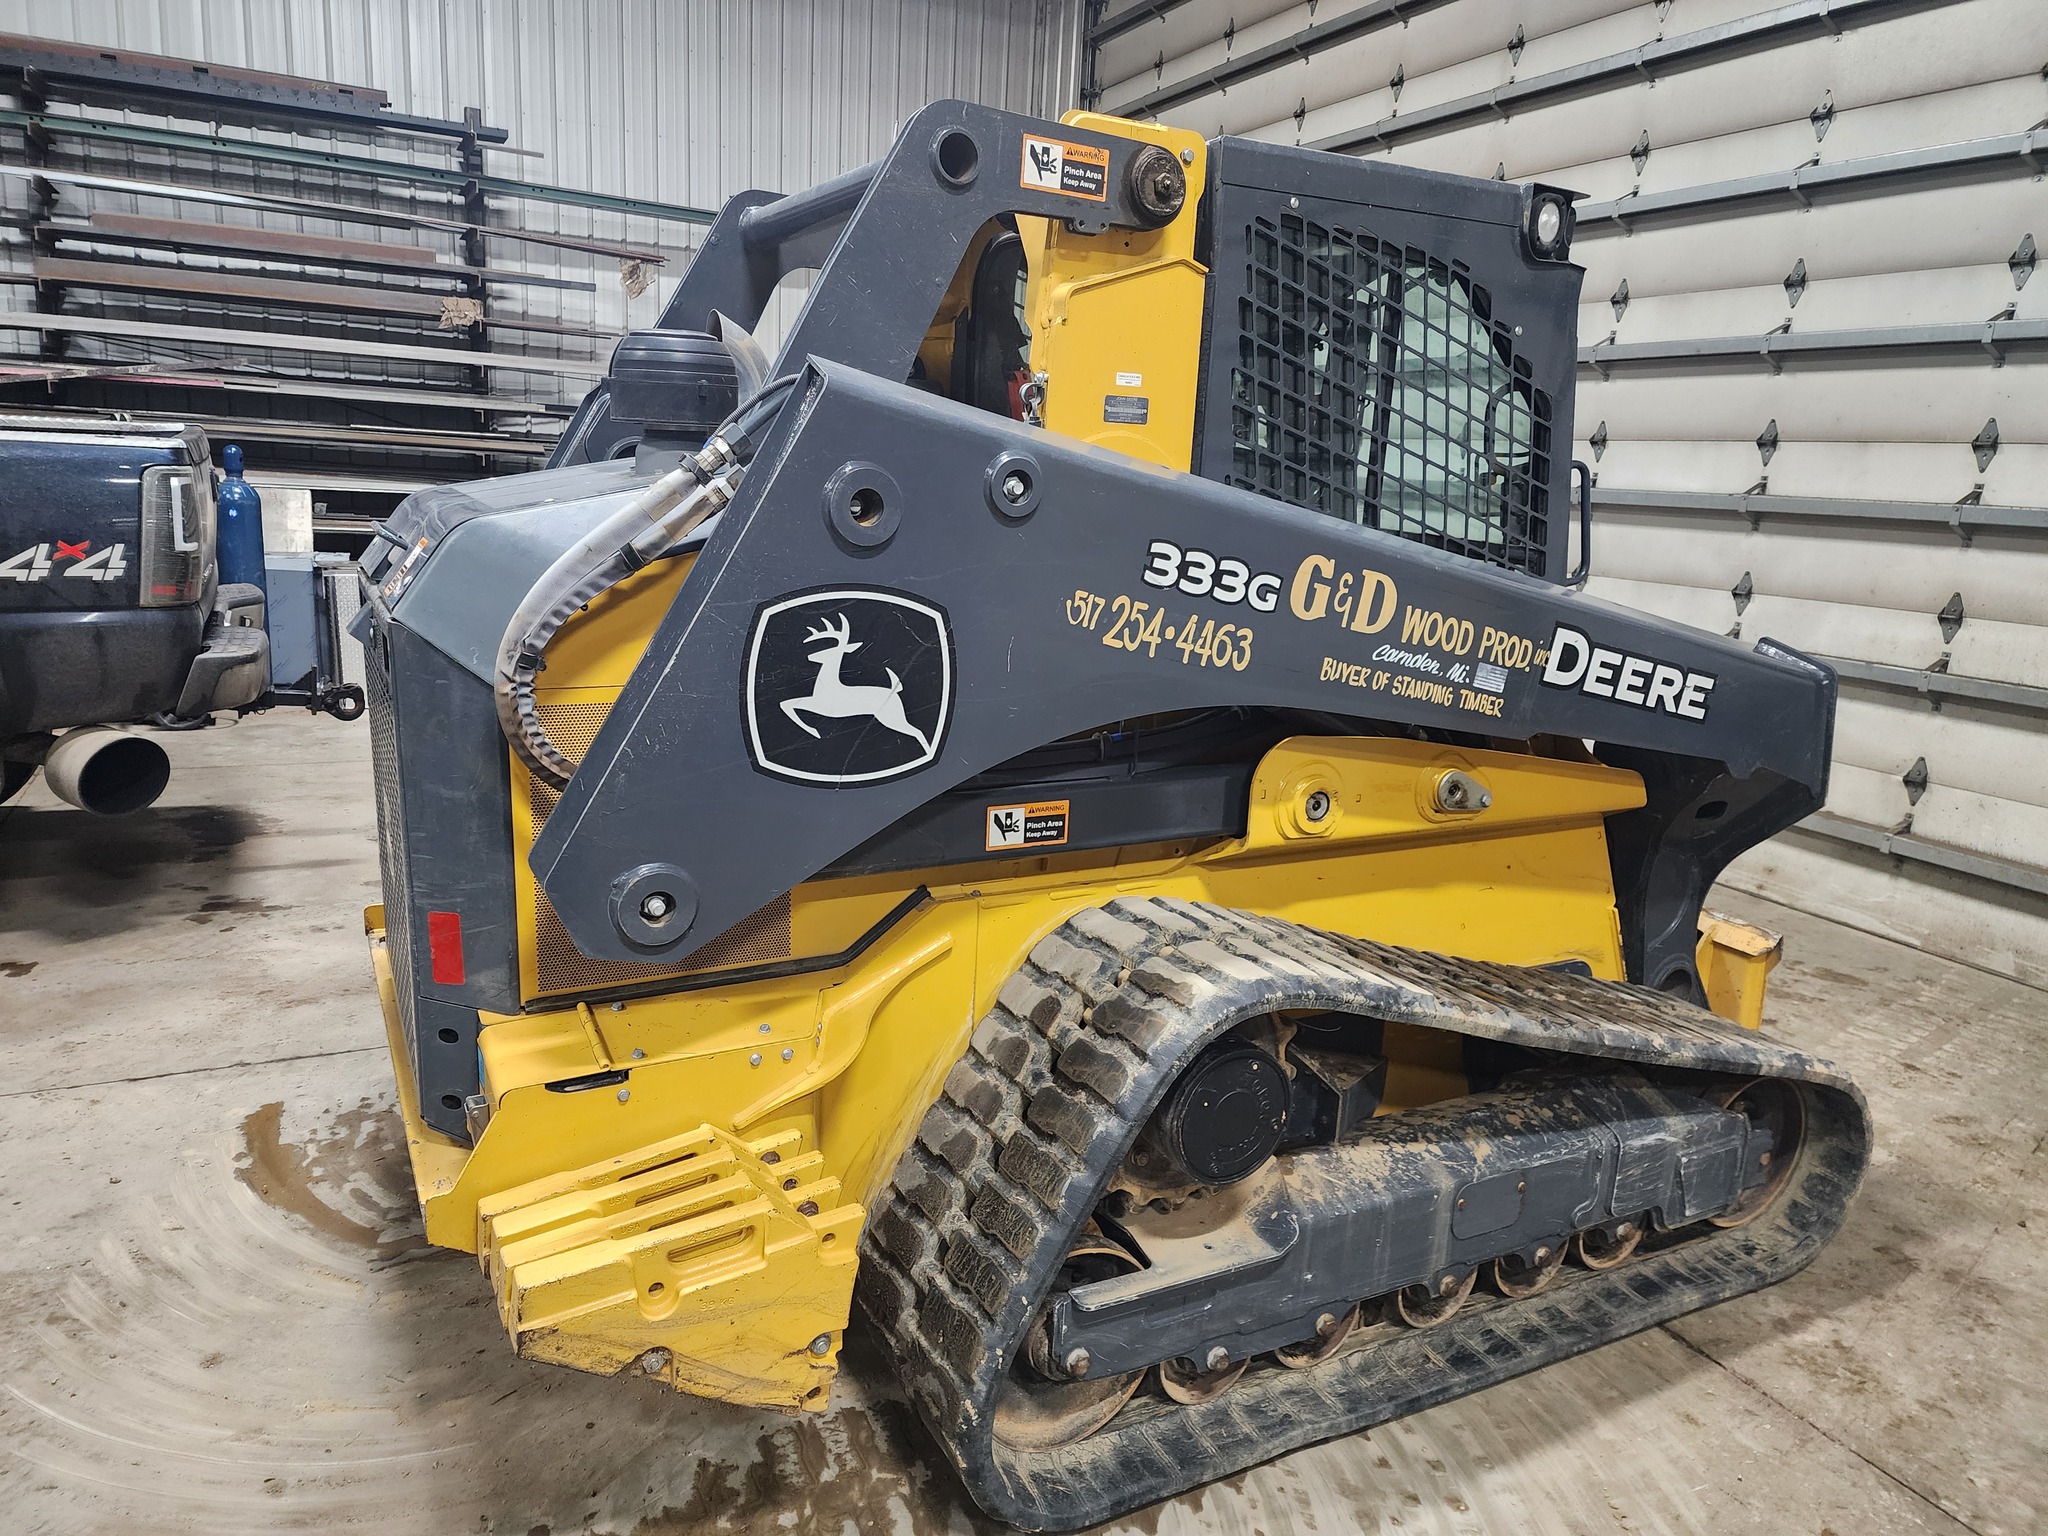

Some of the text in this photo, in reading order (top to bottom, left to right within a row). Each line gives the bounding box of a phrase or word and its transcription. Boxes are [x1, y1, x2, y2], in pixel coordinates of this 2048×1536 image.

[1073, 149, 1105, 162] WARNING
[1064, 166, 1102, 180] Pinch Area
[1063, 177, 1097, 190] Keep Away
[1142, 540, 1282, 612] 333G
[1066, 589, 1106, 630] 517
[1290, 554, 1398, 634] G&D
[1401, 605, 1474, 656] WOOD
[1478, 626, 1533, 672] PROD.
[1372, 644, 1470, 684] Camden, Mi.
[1542, 626, 1715, 720] DEERE
[1320, 657, 1504, 718] BUYER OF STANDING TIMBER
[1035, 804, 1065, 813] WARNING
[1026, 820, 1063, 830] Pinch Area
[1026, 829, 1058, 839] Keep Away
[591, 1174, 610, 1186] USA
[608, 1194, 629, 1207] USA
[621, 1223, 641, 1235] USA
[639, 1246, 660, 1259] USA
